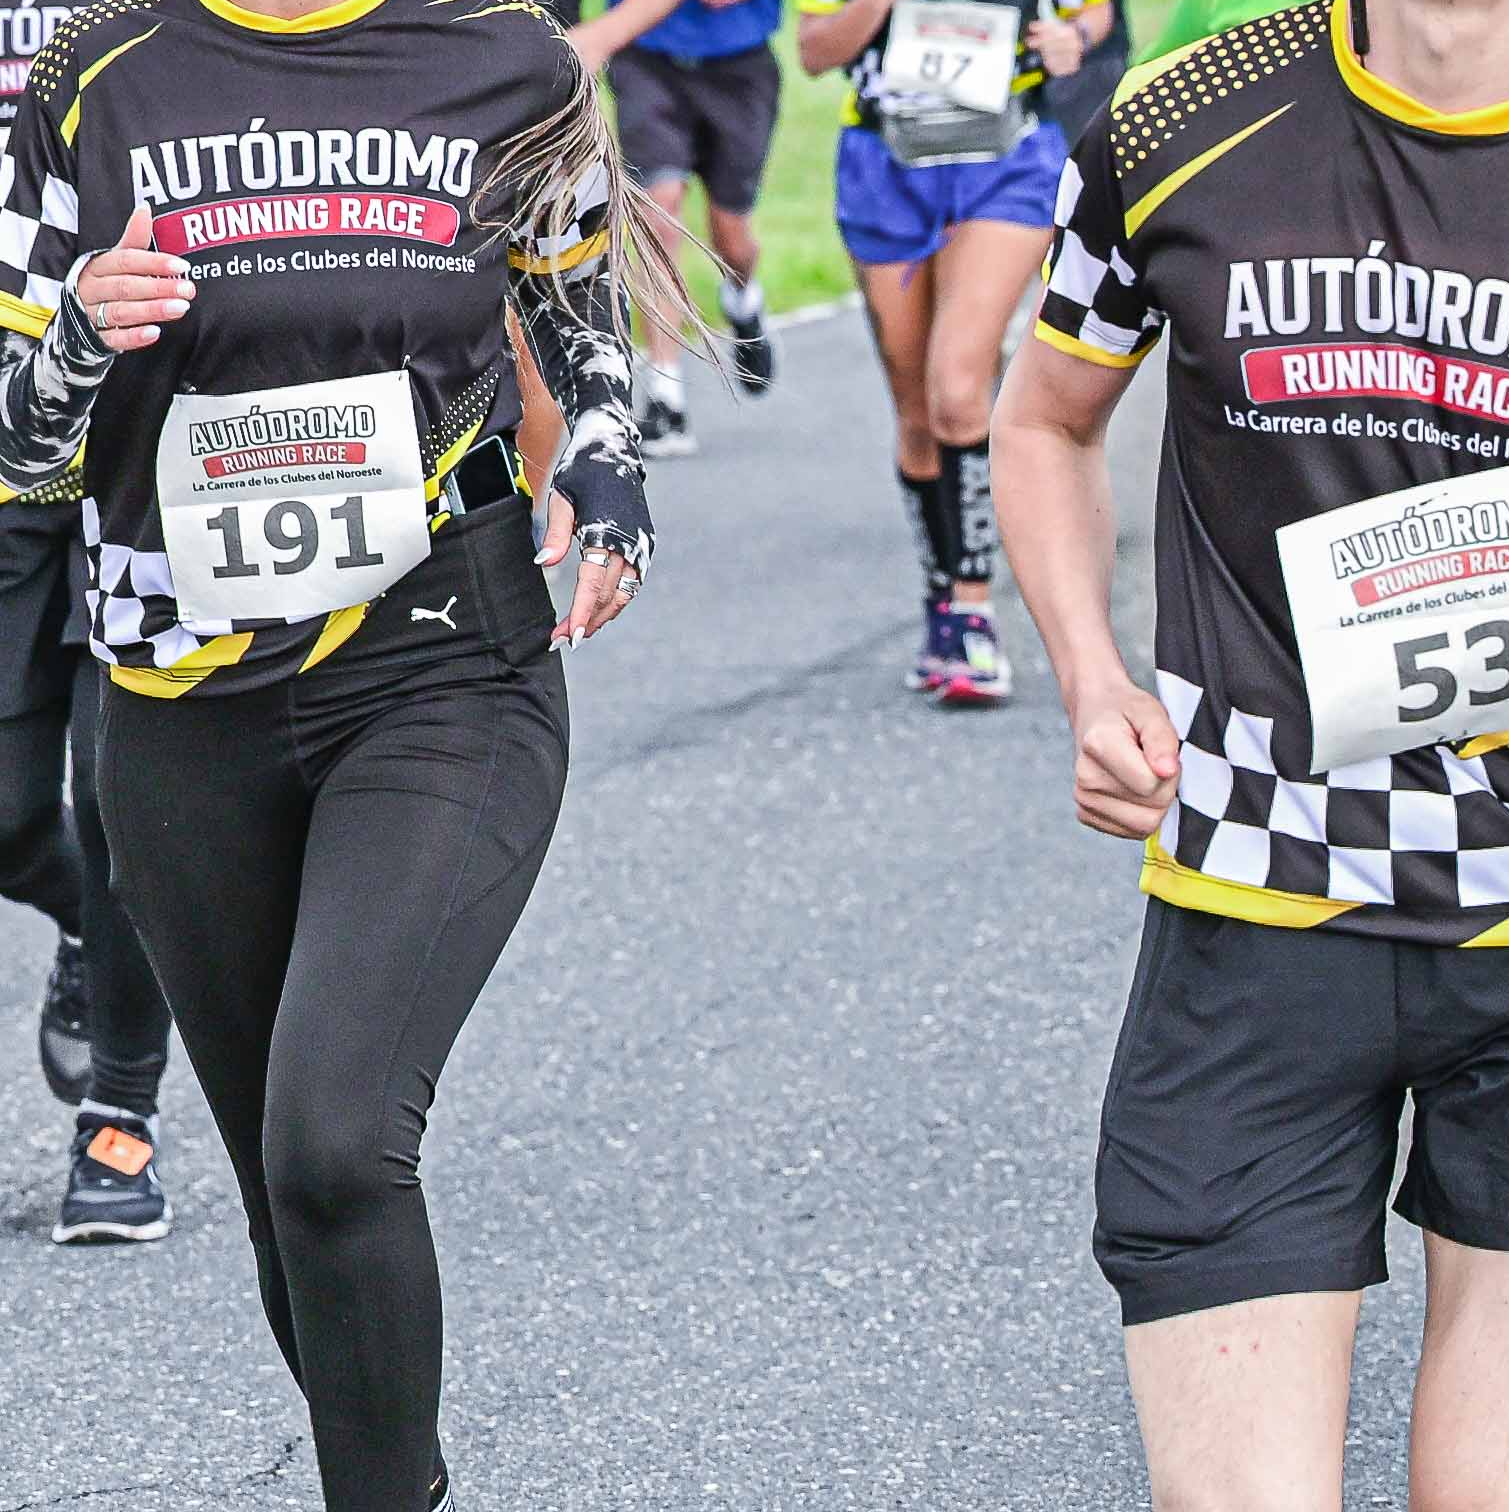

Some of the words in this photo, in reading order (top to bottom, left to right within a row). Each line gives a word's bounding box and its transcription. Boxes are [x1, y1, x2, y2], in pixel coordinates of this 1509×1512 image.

[129, 117, 480, 208] AUTÓDROMO
[182, 197, 329, 249] RUNNING
[339, 197, 427, 237] RACE
[226, 255, 253, 275] de
[257, 253, 287, 274] los
[290, 249, 361, 272] Clubes
[365, 247, 397, 268] del
[402, 248, 476, 274] Noroeste
[1280, 348, 1437, 398] RUNNING
[189, 405, 376, 456] AUTÓDROMO
[1223, 405, 1246, 428] La
[1247, 410, 1328, 435] Carrera
[1332, 413, 1362, 436] de
[1366, 413, 1398, 439] los
[1466, 433, 1500, 458] del
[192, 482, 205, 492] La
[207, 480, 246, 491] Carrera
[247, 477, 262, 487] de
[264, 474, 280, 485] los
[281, 472, 316, 484] Clubes
[318, 470, 335, 481] del
[336, 467, 383, 479] Noroeste
[221, 447, 297, 474] RUNNING
[302, 445, 347, 465] RACE
[206, 495, 385, 579] 191
[1372, 555, 1465, 598] RUNNING
[1339, 616, 1354, 628] La
[1356, 606, 1403, 624] Carrera
[1405, 601, 1422, 614] de
[1424, 597, 1442, 609] los
[1444, 589, 1487, 605] Clubes
[1489, 585, 1507, 597] del
